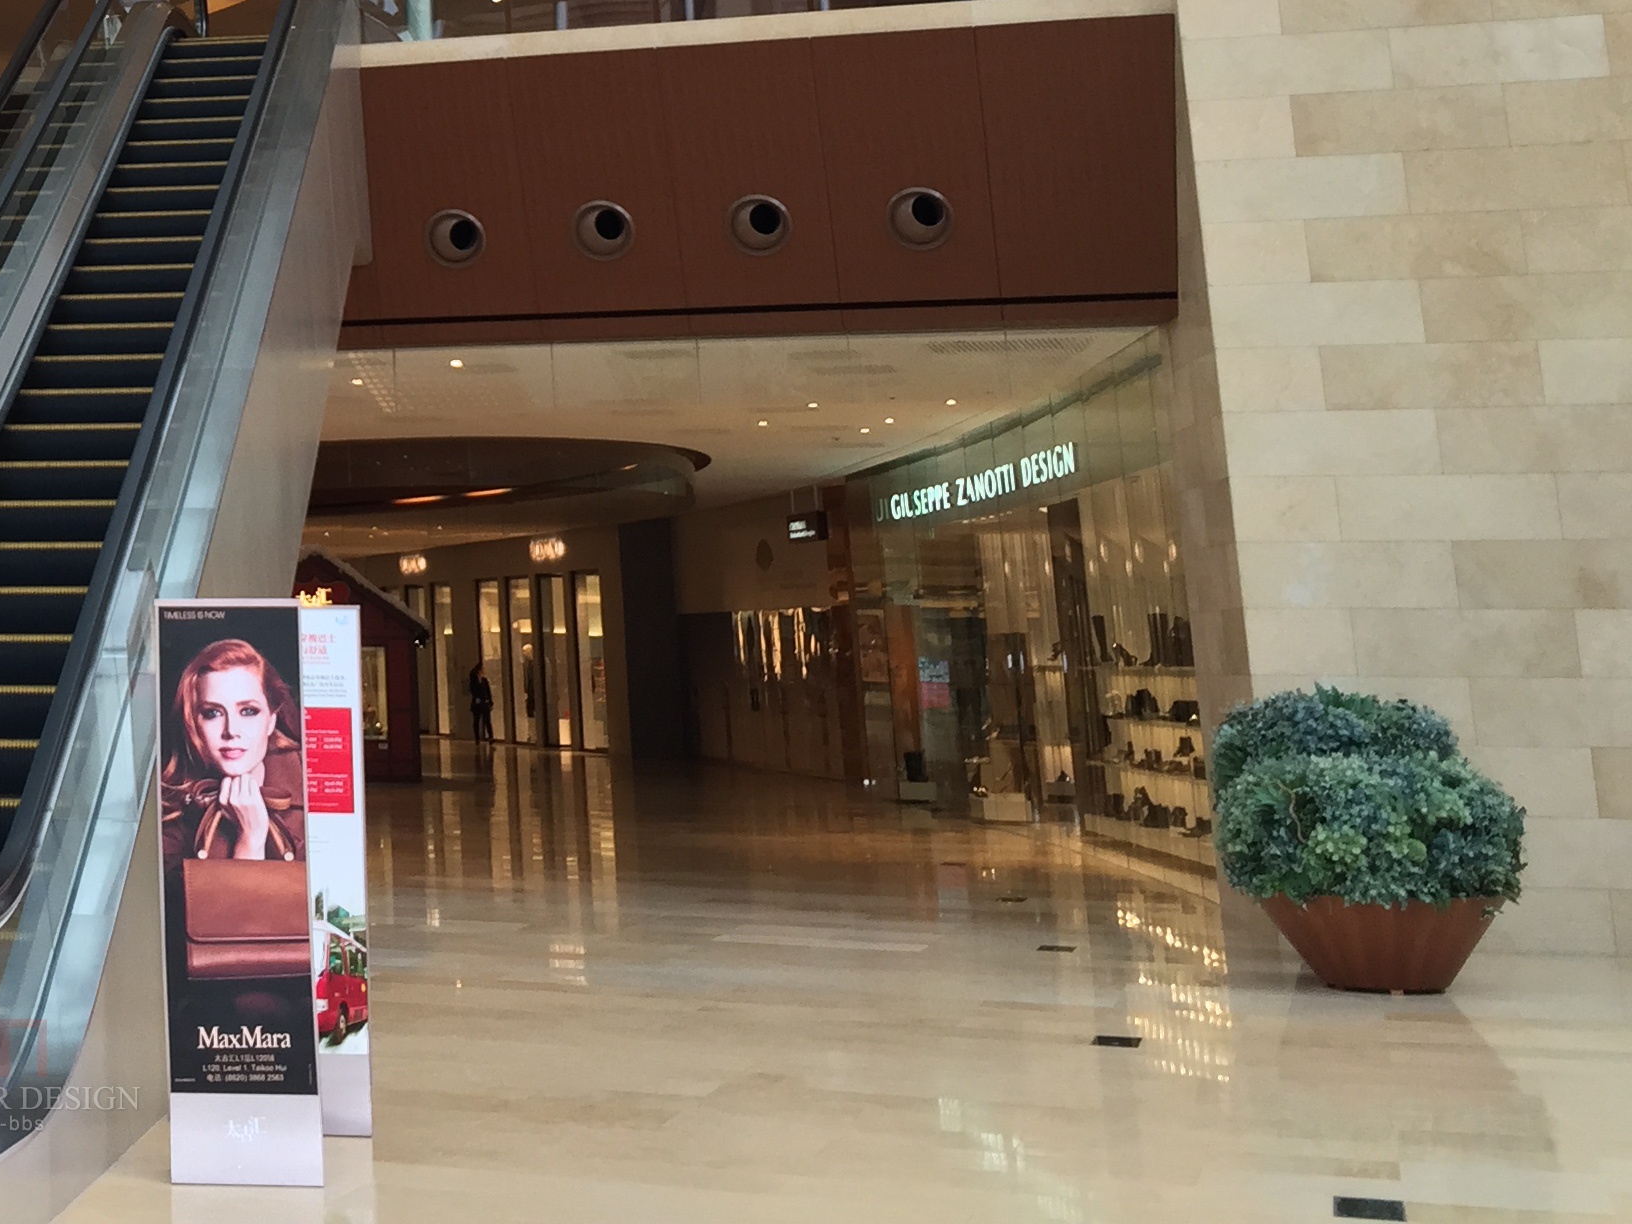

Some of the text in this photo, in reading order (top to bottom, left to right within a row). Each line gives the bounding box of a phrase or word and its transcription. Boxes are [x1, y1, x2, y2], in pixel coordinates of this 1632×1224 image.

[954, 462, 1016, 507] ZANOTTI
[1020, 440, 1076, 489] DESIGN
[163, 610, 196, 620] TIMELESS
[204, 610, 226, 620] NOW
[197, 1025, 292, 1049] MaxMara
